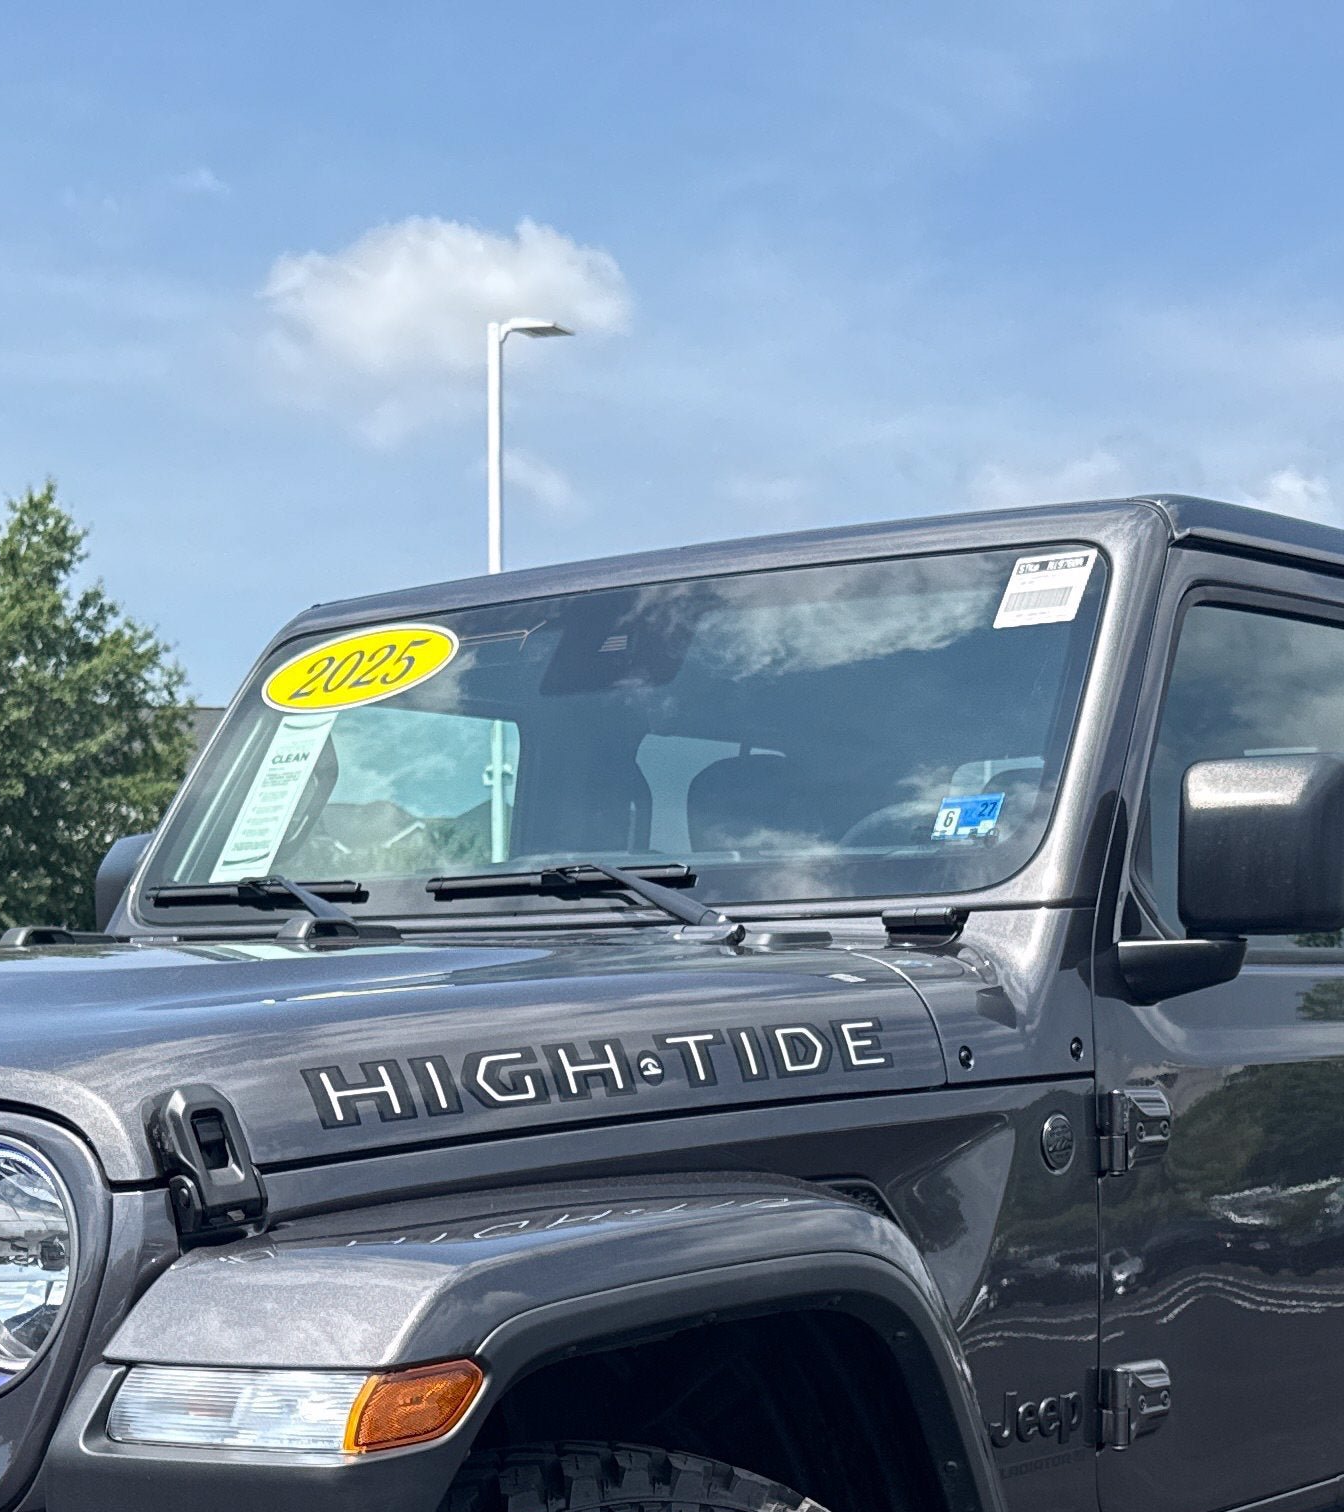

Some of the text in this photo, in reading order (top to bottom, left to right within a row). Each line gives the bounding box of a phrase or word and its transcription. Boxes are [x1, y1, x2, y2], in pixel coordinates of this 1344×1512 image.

[287, 638, 432, 700] 2025
[271, 752, 310, 765] CLEAN
[943, 811, 955, 828] 6
[977, 801, 997, 816] 27
[301, 1016, 900, 1130] HIGH TIDE
[989, 1391, 1082, 1448] Jeep
